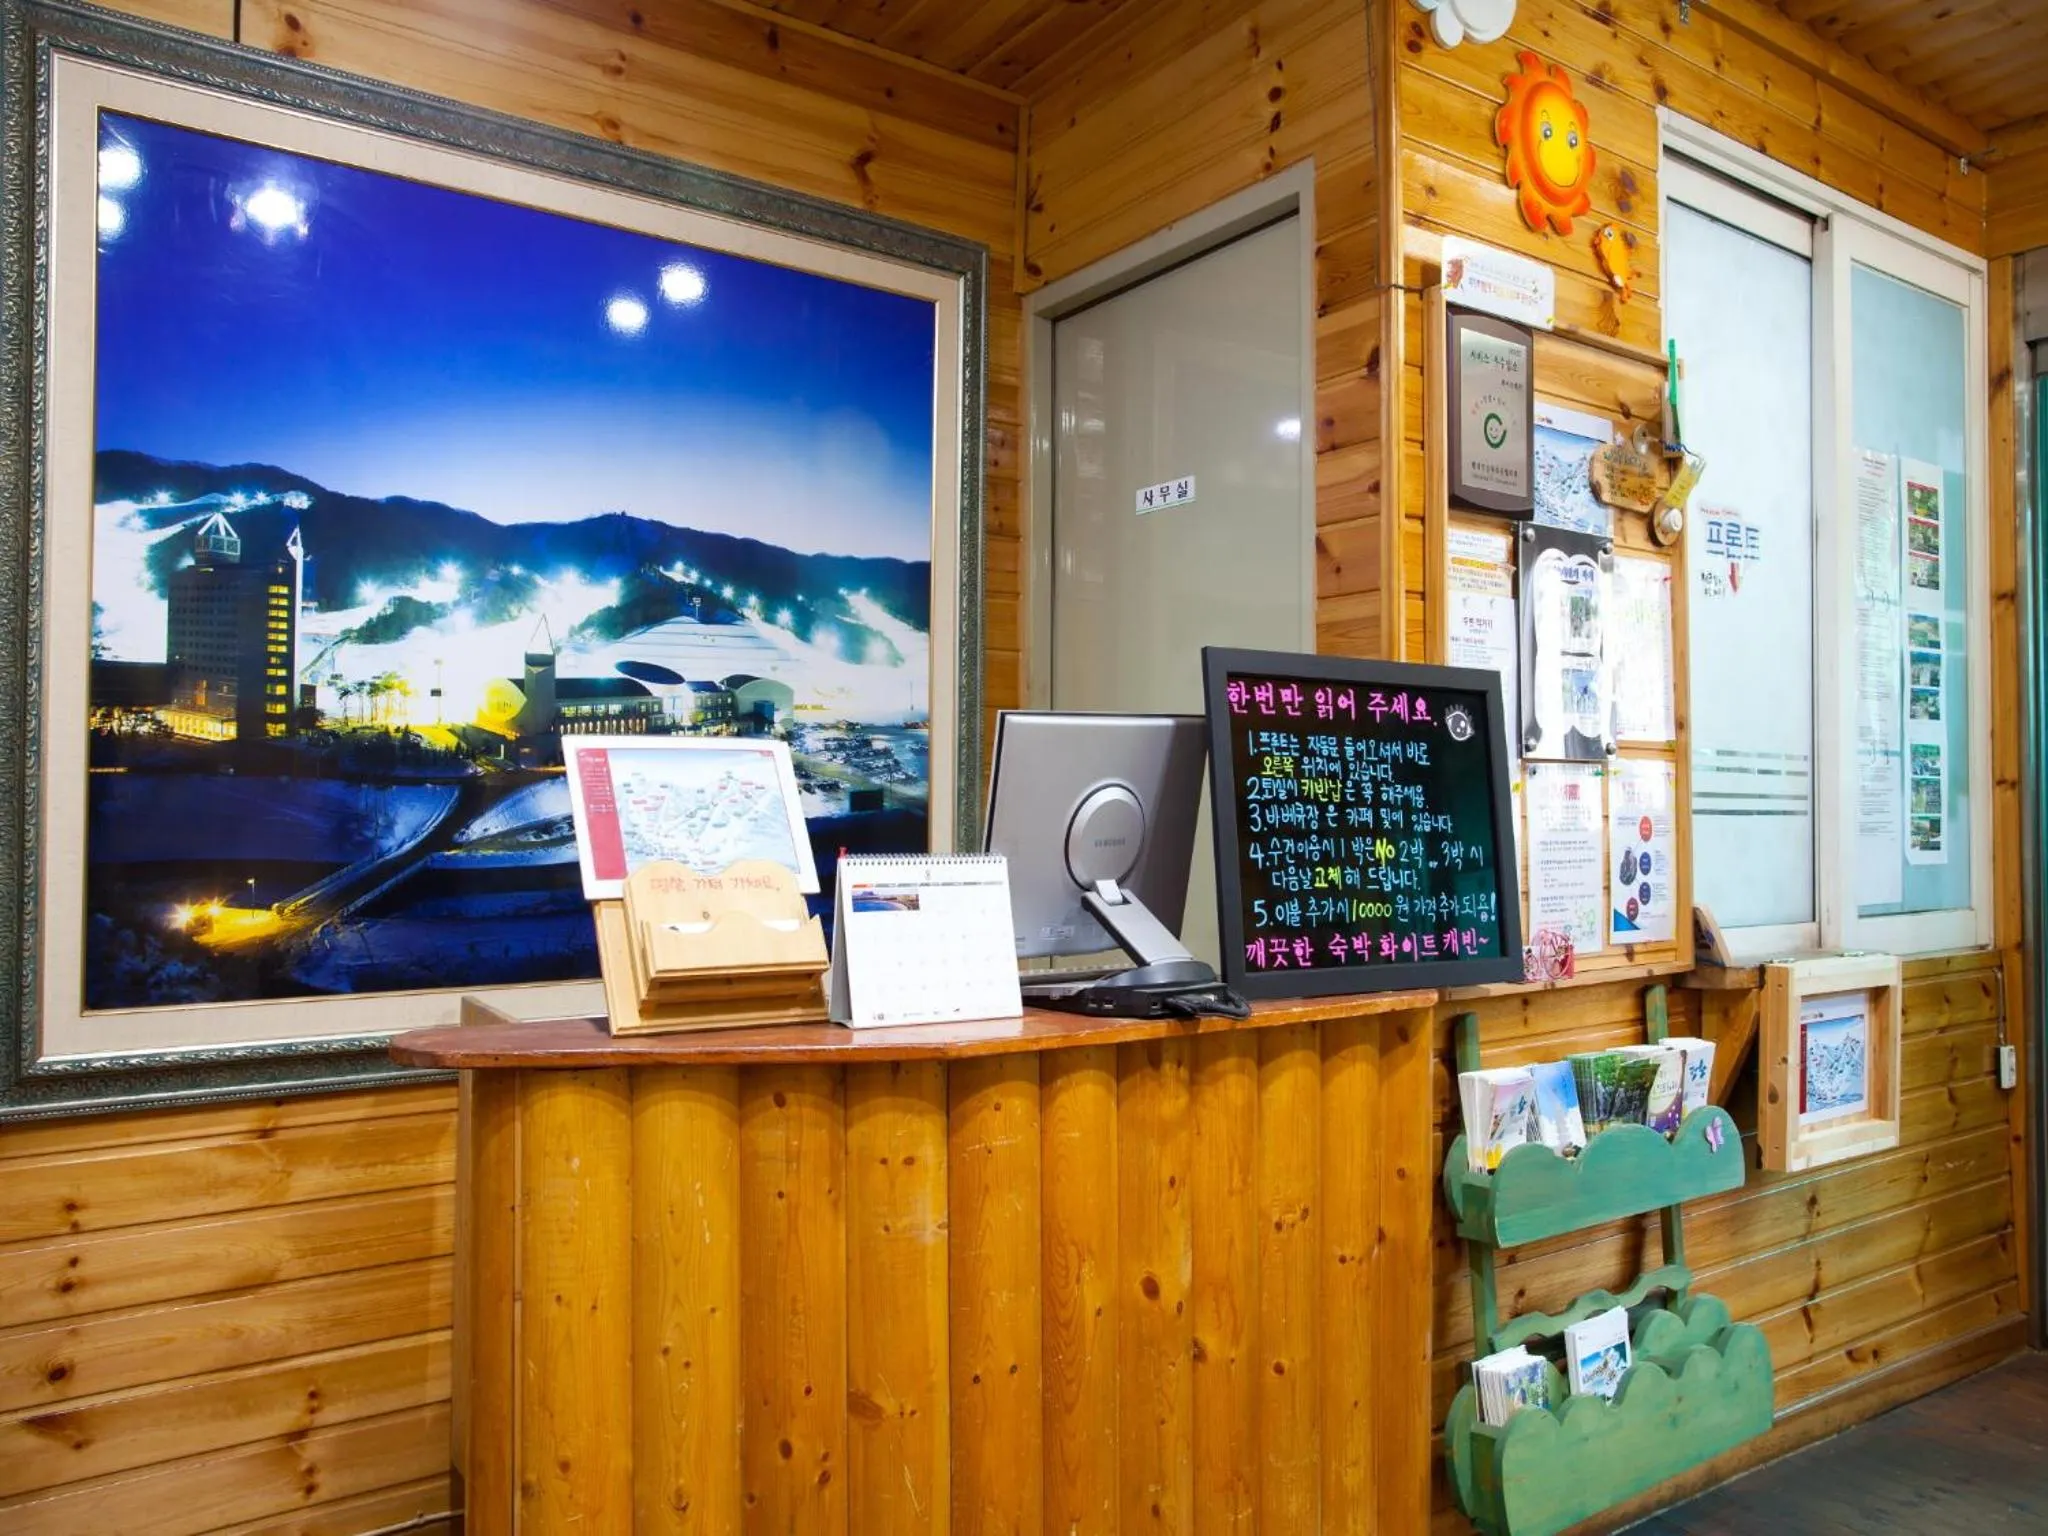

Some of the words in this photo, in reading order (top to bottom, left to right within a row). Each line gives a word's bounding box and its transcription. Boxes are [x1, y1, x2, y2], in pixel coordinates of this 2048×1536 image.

[1143, 480, 1188, 506] 사무실
[1706, 521, 1760, 560] 프론트
[1227, 680, 1303, 716] 한번만
[1314, 687, 1355, 720] 읽어
[1367, 692, 1438, 726] 주세요.
[1307, 735, 1339, 758] 자동문
[1406, 742, 1431, 766] 바로
[1261, 756, 1294, 778] 오른쪽
[1300, 756, 1341, 780] 위치에
[1361, 782, 1374, 805] 꼭
[1346, 807, 1373, 828] 카페
[1381, 809, 1403, 830] 밑에
[1375, 836, 1396, 866] No
[1367, 866, 1421, 891] 드립니다.
[1246, 936, 1313, 969] 깨끗한
[1328, 931, 1371, 963] 숙박
